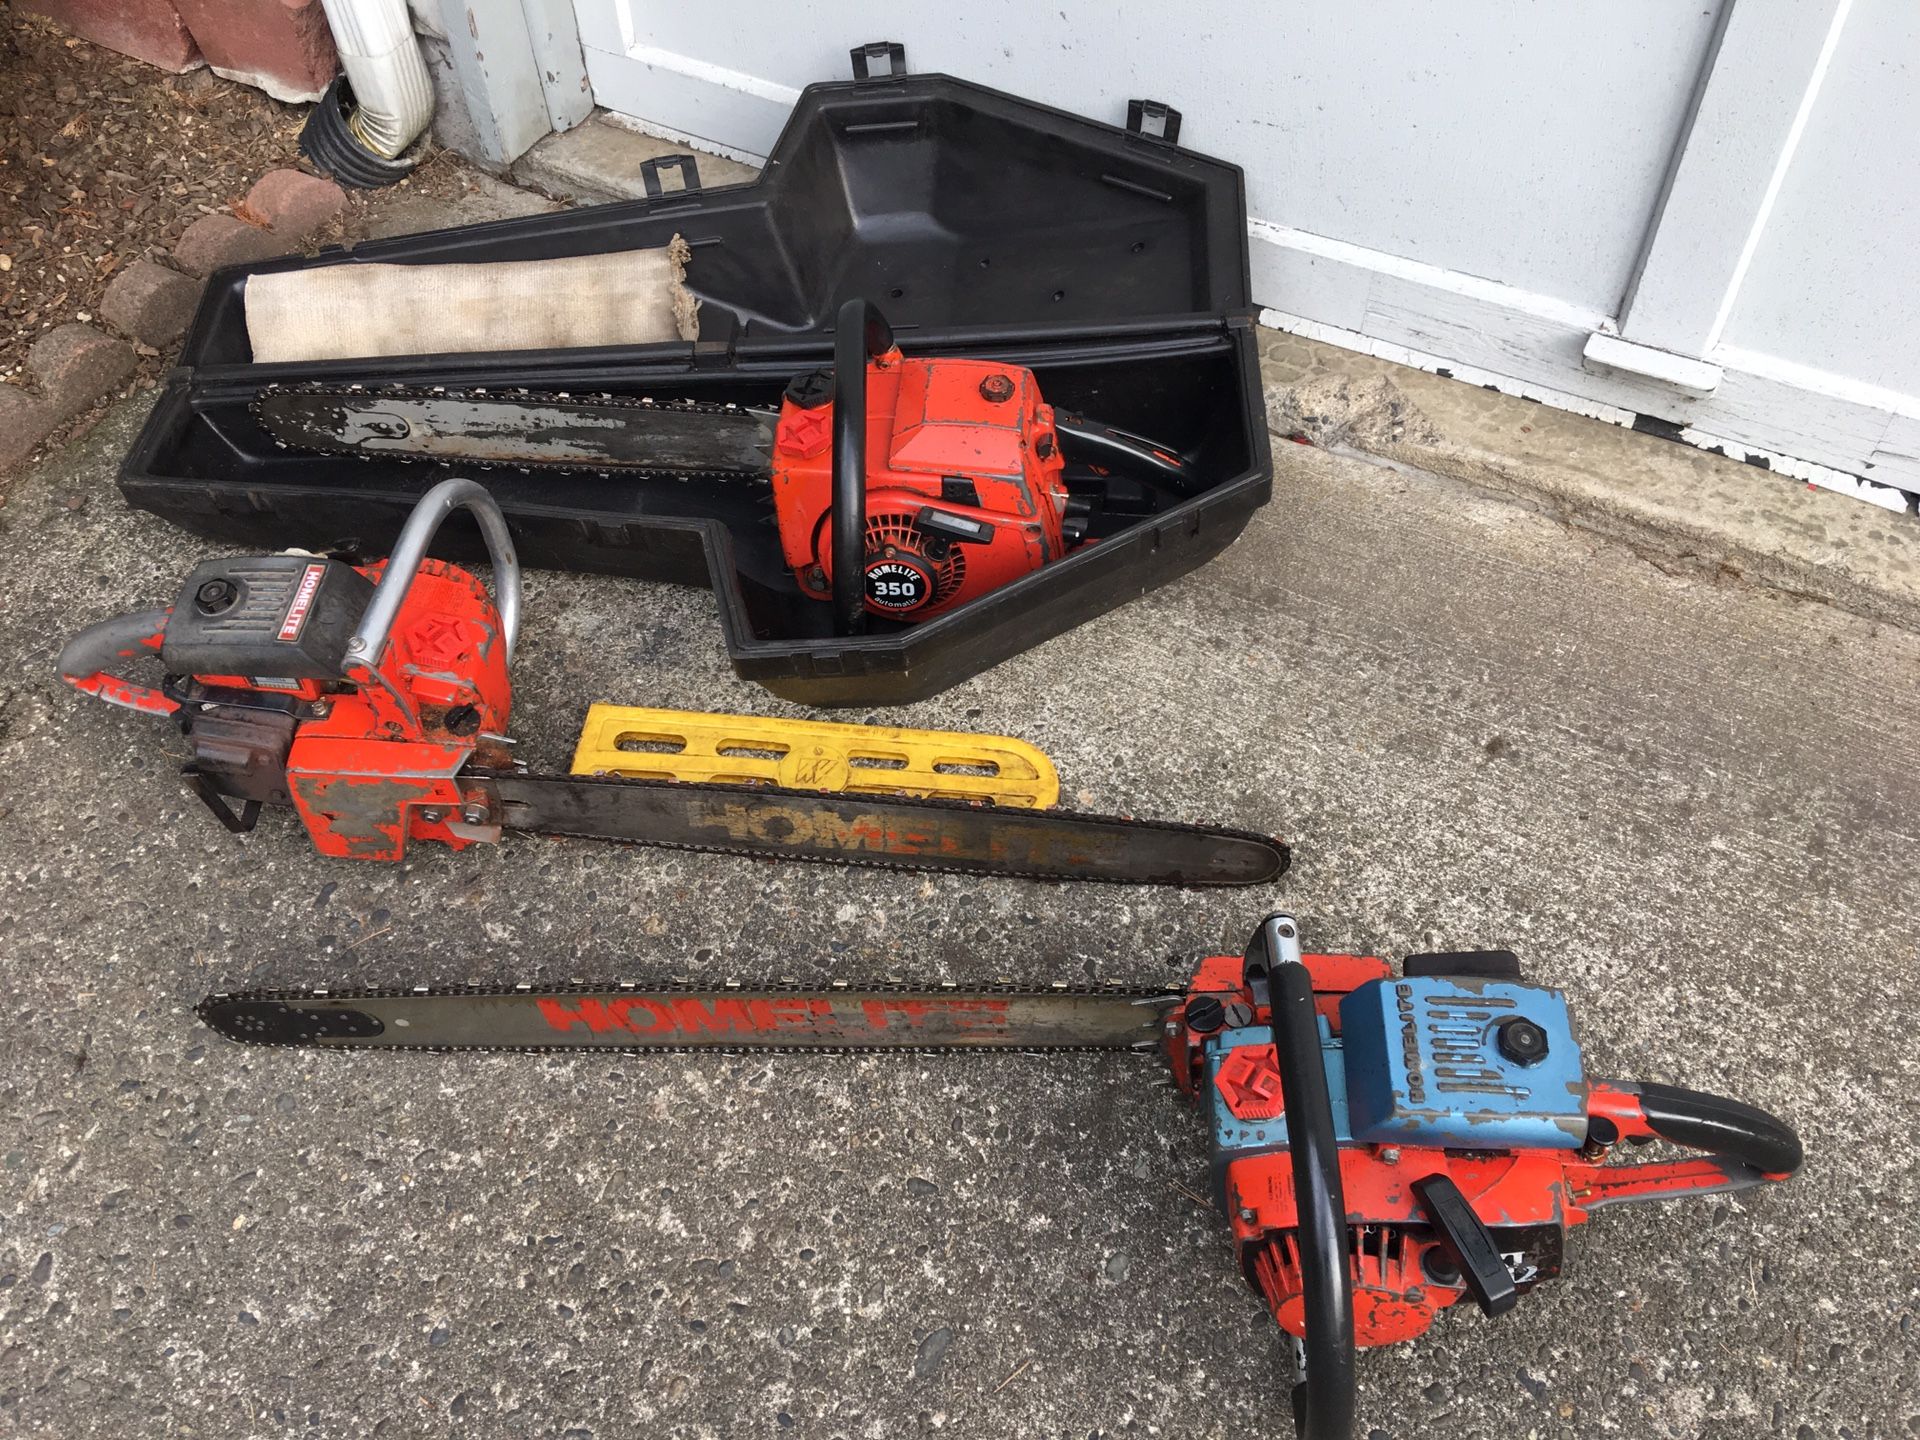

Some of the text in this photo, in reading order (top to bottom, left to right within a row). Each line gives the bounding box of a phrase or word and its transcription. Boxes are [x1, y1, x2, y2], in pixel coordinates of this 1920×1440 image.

[867, 564, 921, 581] HOMELITE
[874, 581, 915, 596] 350
[284, 571, 320, 633] HOMELITE
[873, 596, 918, 608] automatic
[1396, 984, 1425, 1104] HOMELITE
